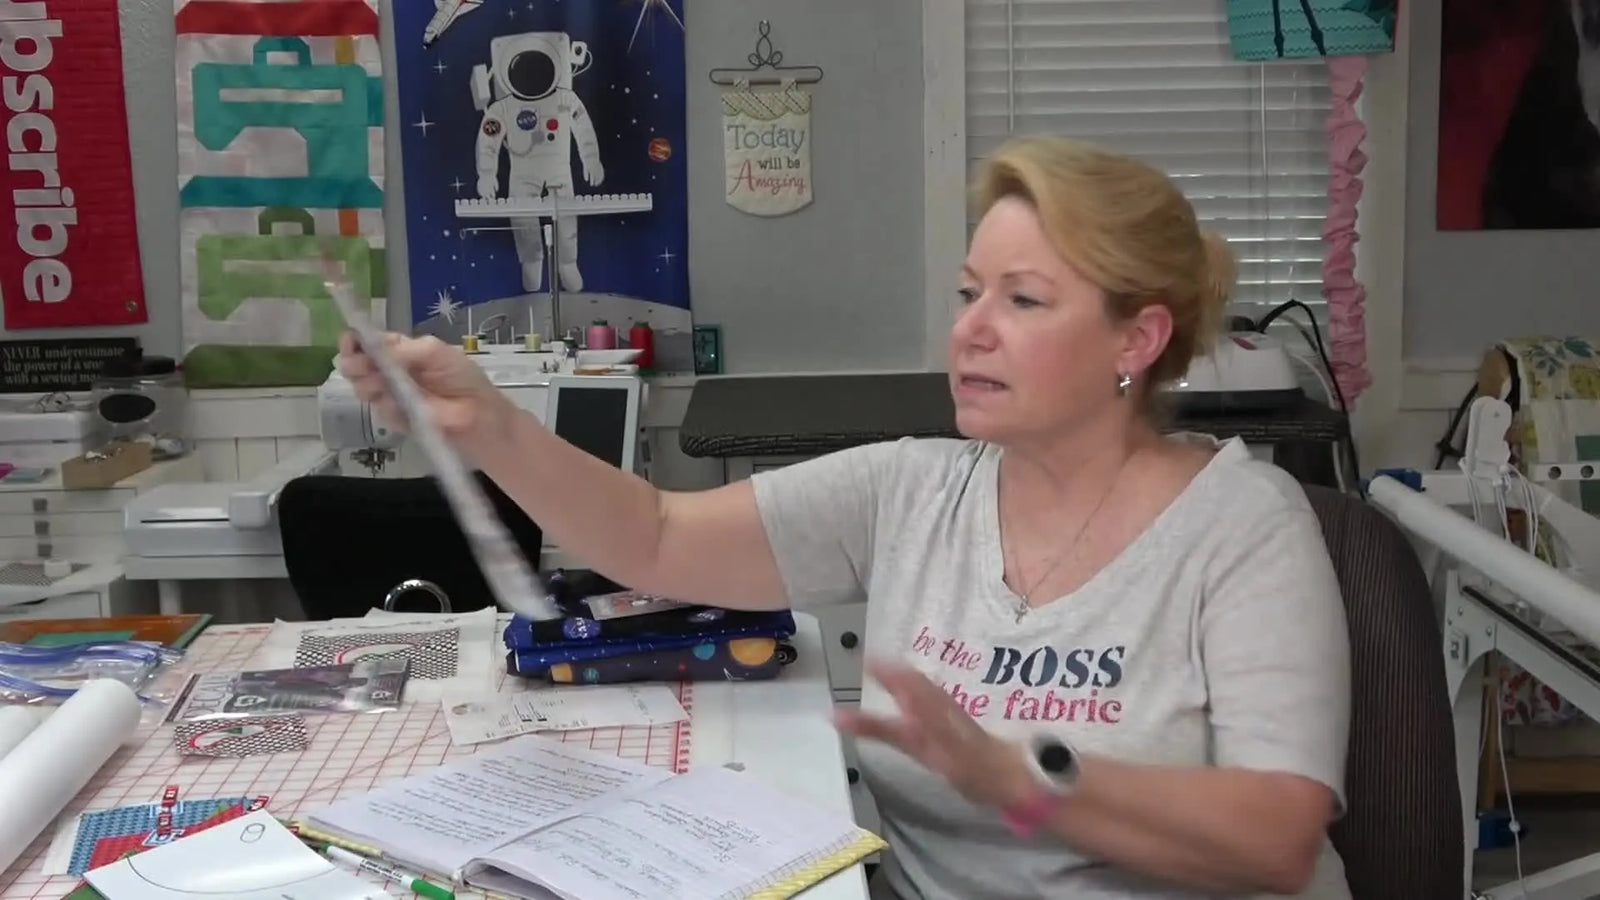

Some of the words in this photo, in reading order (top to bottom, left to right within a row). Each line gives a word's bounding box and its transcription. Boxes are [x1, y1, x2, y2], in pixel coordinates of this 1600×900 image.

[727, 124, 805, 154] Today
[757, 157, 782, 170] will
[787, 157, 801, 169] be
[728, 160, 806, 195] Amazing
[2, 346, 41, 359] NEVER
[44, 345, 126, 358] underestimate
[4, 359, 21, 371] the
[24, 361, 59, 374] power
[60, 357, 72, 371] of
[74, 362, 82, 371] a
[5, 372, 29, 385] with
[41, 373, 77, 386] sewing
[913, 626, 936, 657] be
[940, 638, 982, 671] the
[981, 645, 1125, 688] BOSS
[942, 681, 989, 717] he
[1003, 688, 1122, 724] fabric
